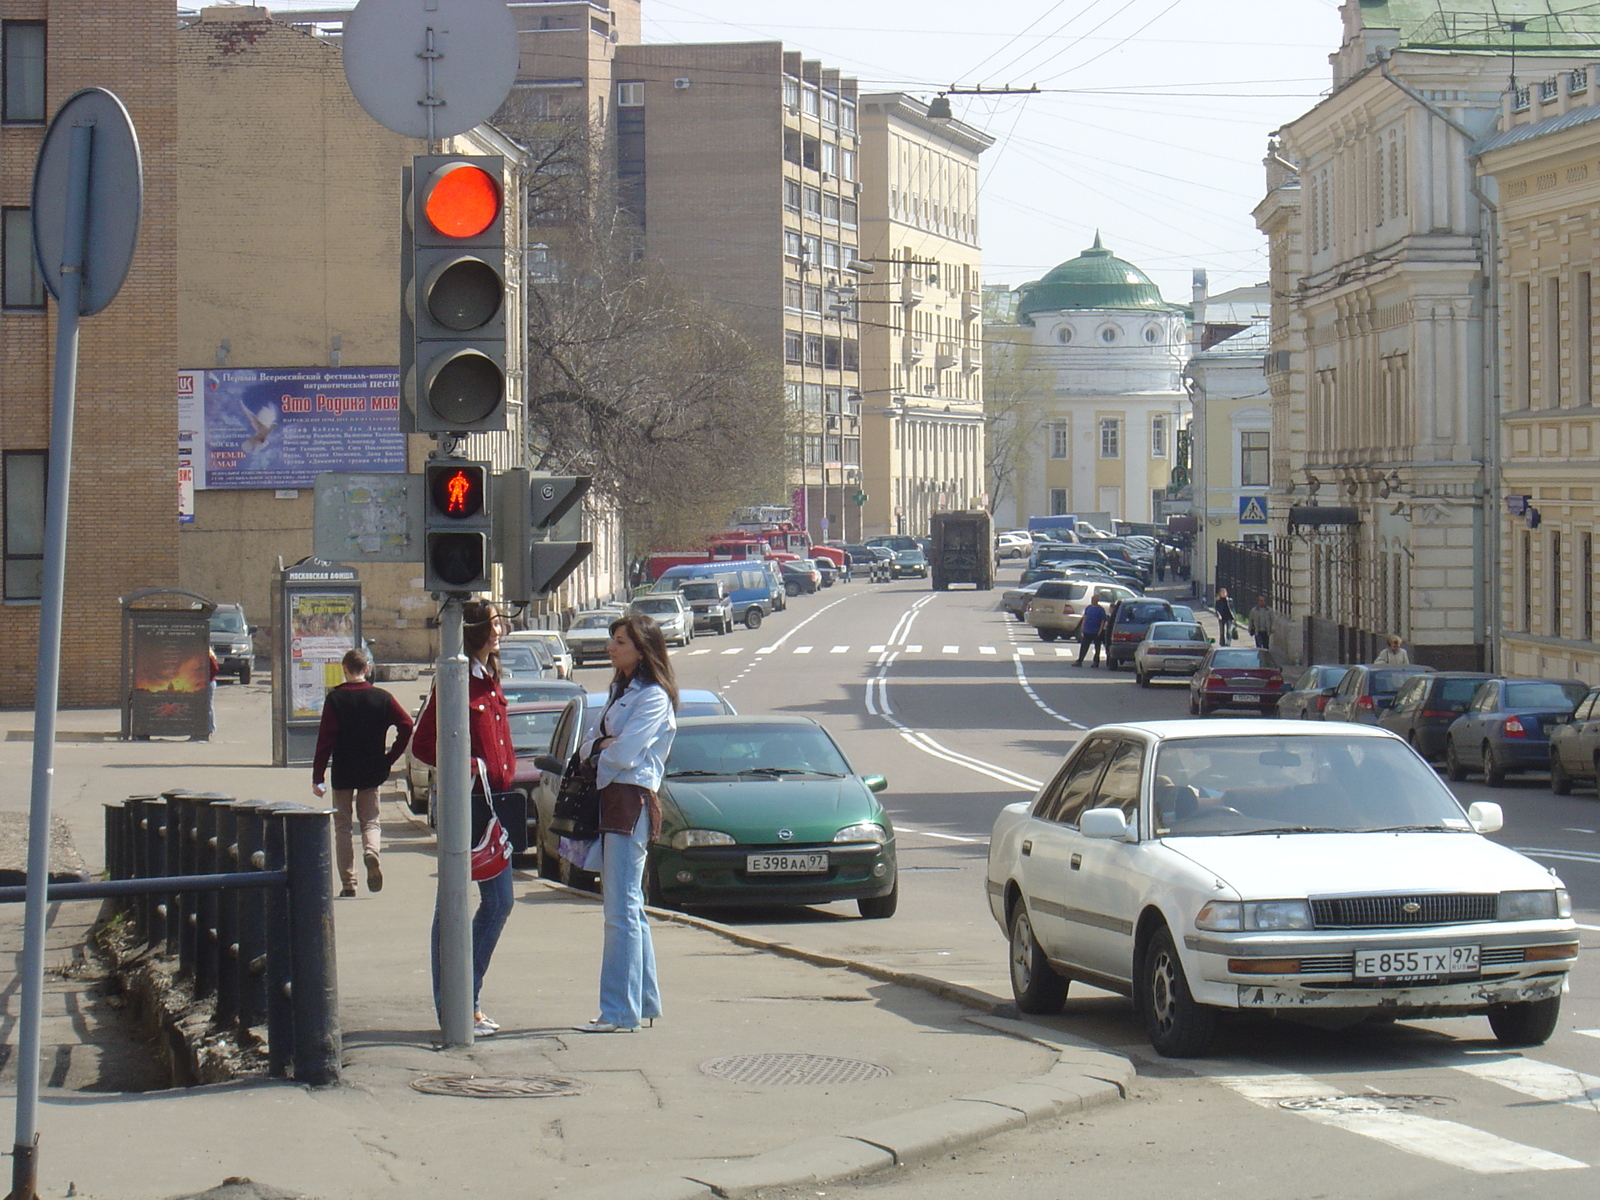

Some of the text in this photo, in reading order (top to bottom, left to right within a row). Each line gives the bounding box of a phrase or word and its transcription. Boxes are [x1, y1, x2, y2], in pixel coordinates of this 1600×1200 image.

[222, 373, 257, 383] Первый
[260, 372, 320, 383] Всероссийский
[303, 382, 367, 390] патриотической
[282, 394, 400, 415] Это Родина моя
[289, 572, 329, 580] МОСКОВСКАЯ
[1453, 947, 1473, 963] 97
